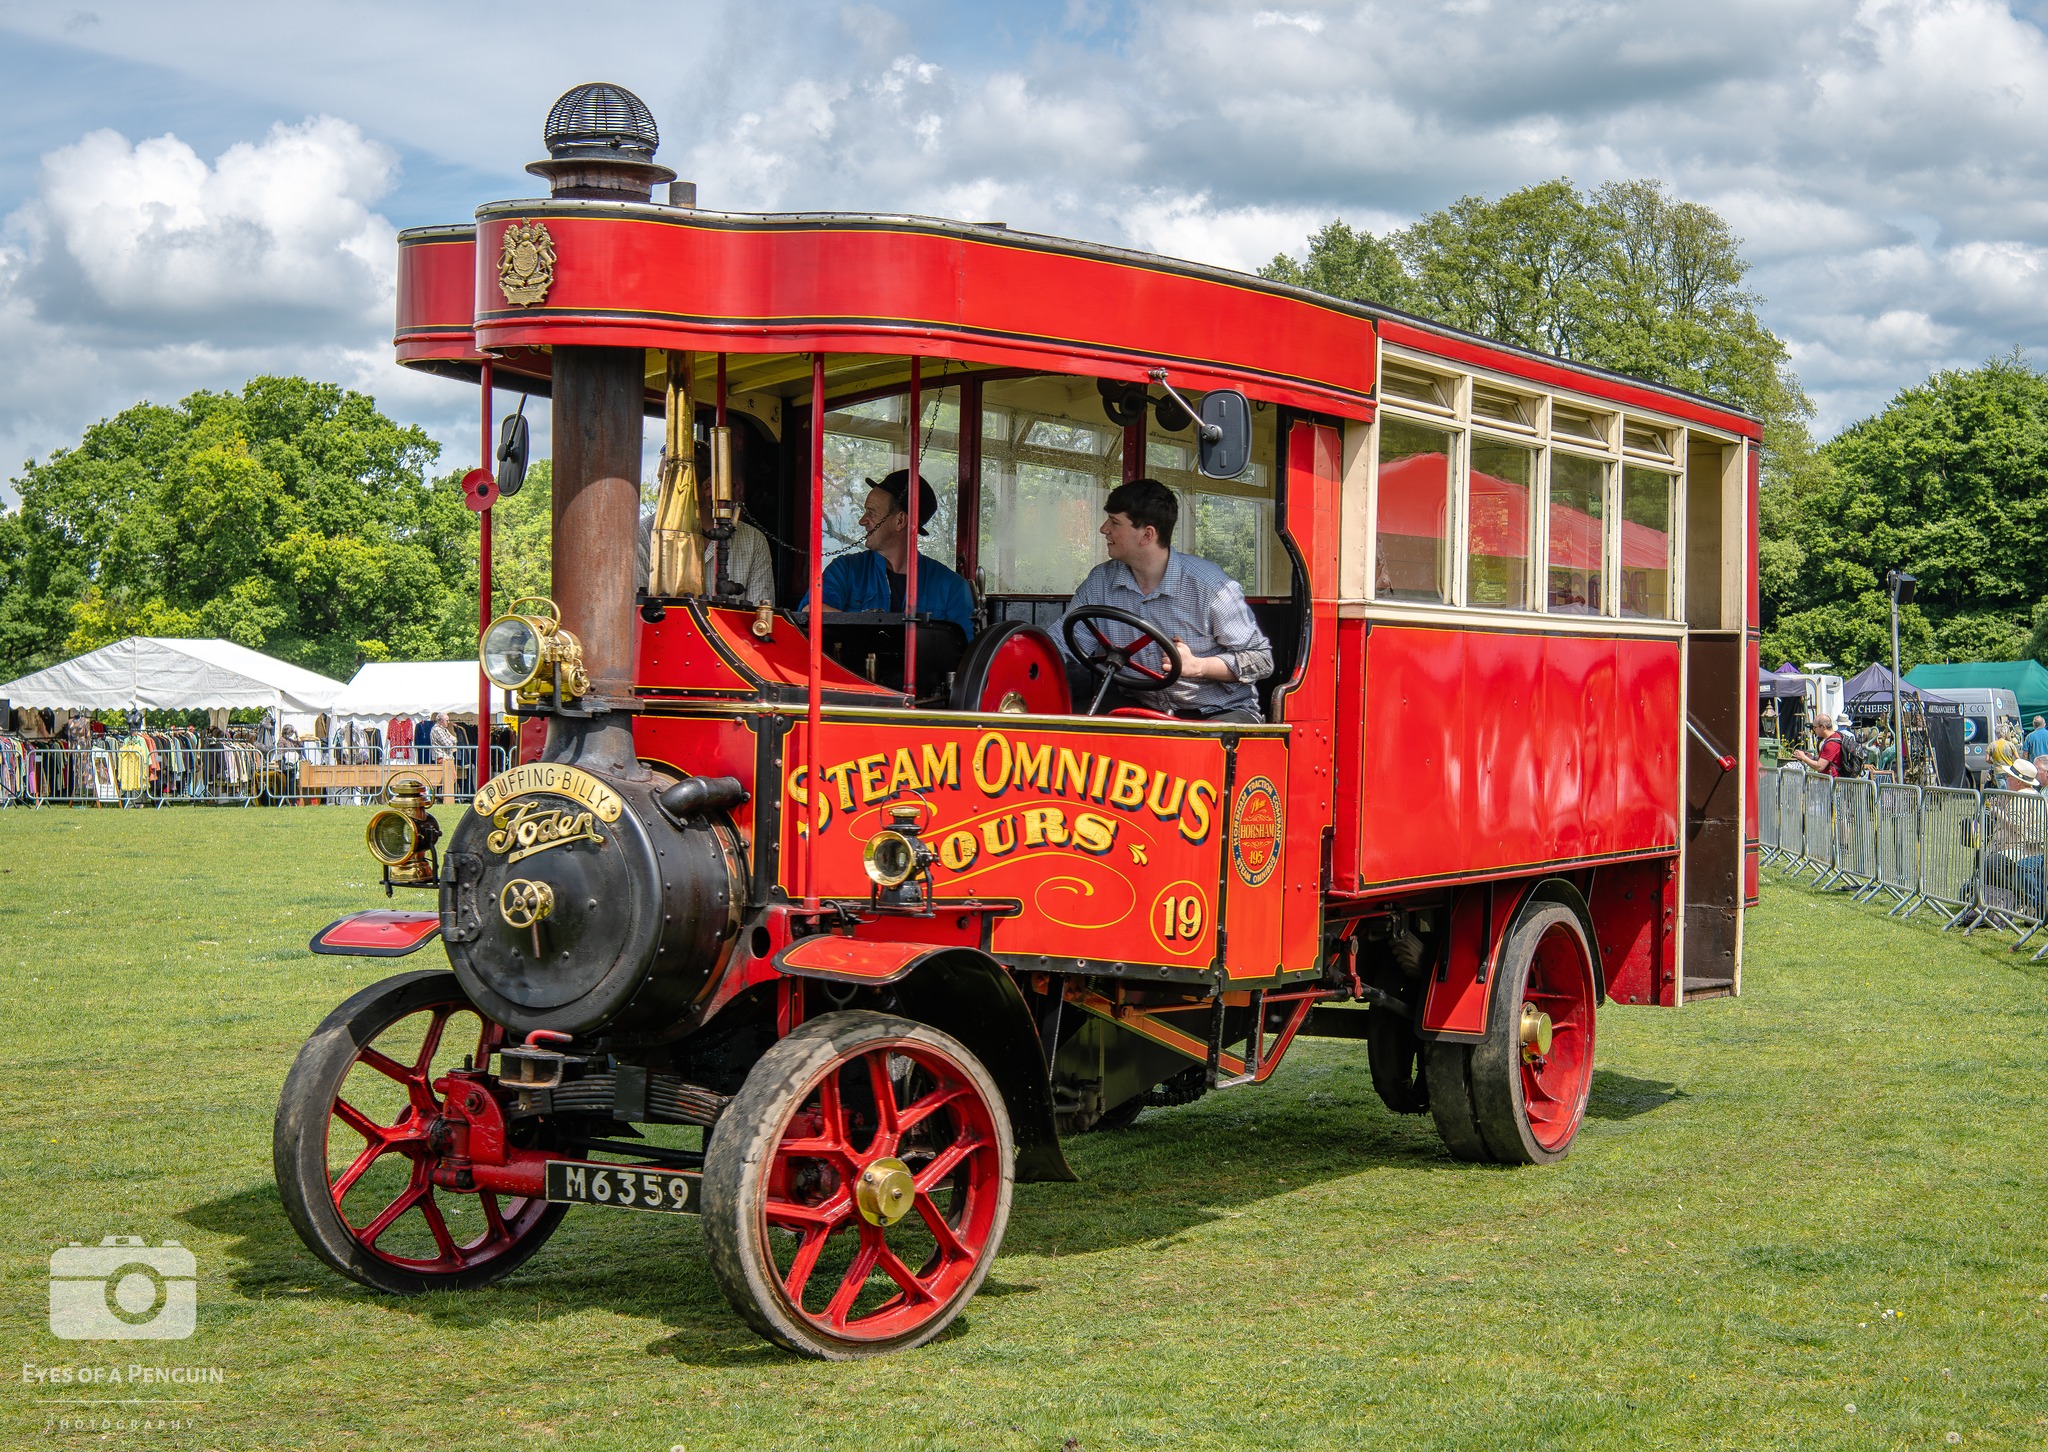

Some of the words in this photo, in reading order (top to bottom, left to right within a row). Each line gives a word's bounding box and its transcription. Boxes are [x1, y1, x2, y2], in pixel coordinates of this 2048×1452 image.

[486, 767, 555, 804] PUFFING
[562, 771, 610, 809] BILLY
[787, 741, 960, 836] STEAM
[971, 731, 1218, 845] OMNIBUS
[487, 801, 605, 864] Foden
[1240, 823, 1275, 839] HORSHAM
[1247, 779, 1273, 795] TRACTION
[1272, 795, 1282, 843] COMPANY
[922, 806, 1118, 876] OURS
[1250, 850, 1263, 865] 195
[1236, 857, 1251, 882] STEAM
[1252, 855, 1276, 883] OMNIBUS
[1162, 895, 1203, 940] 19
[565, 1166, 689, 1209] M6359
